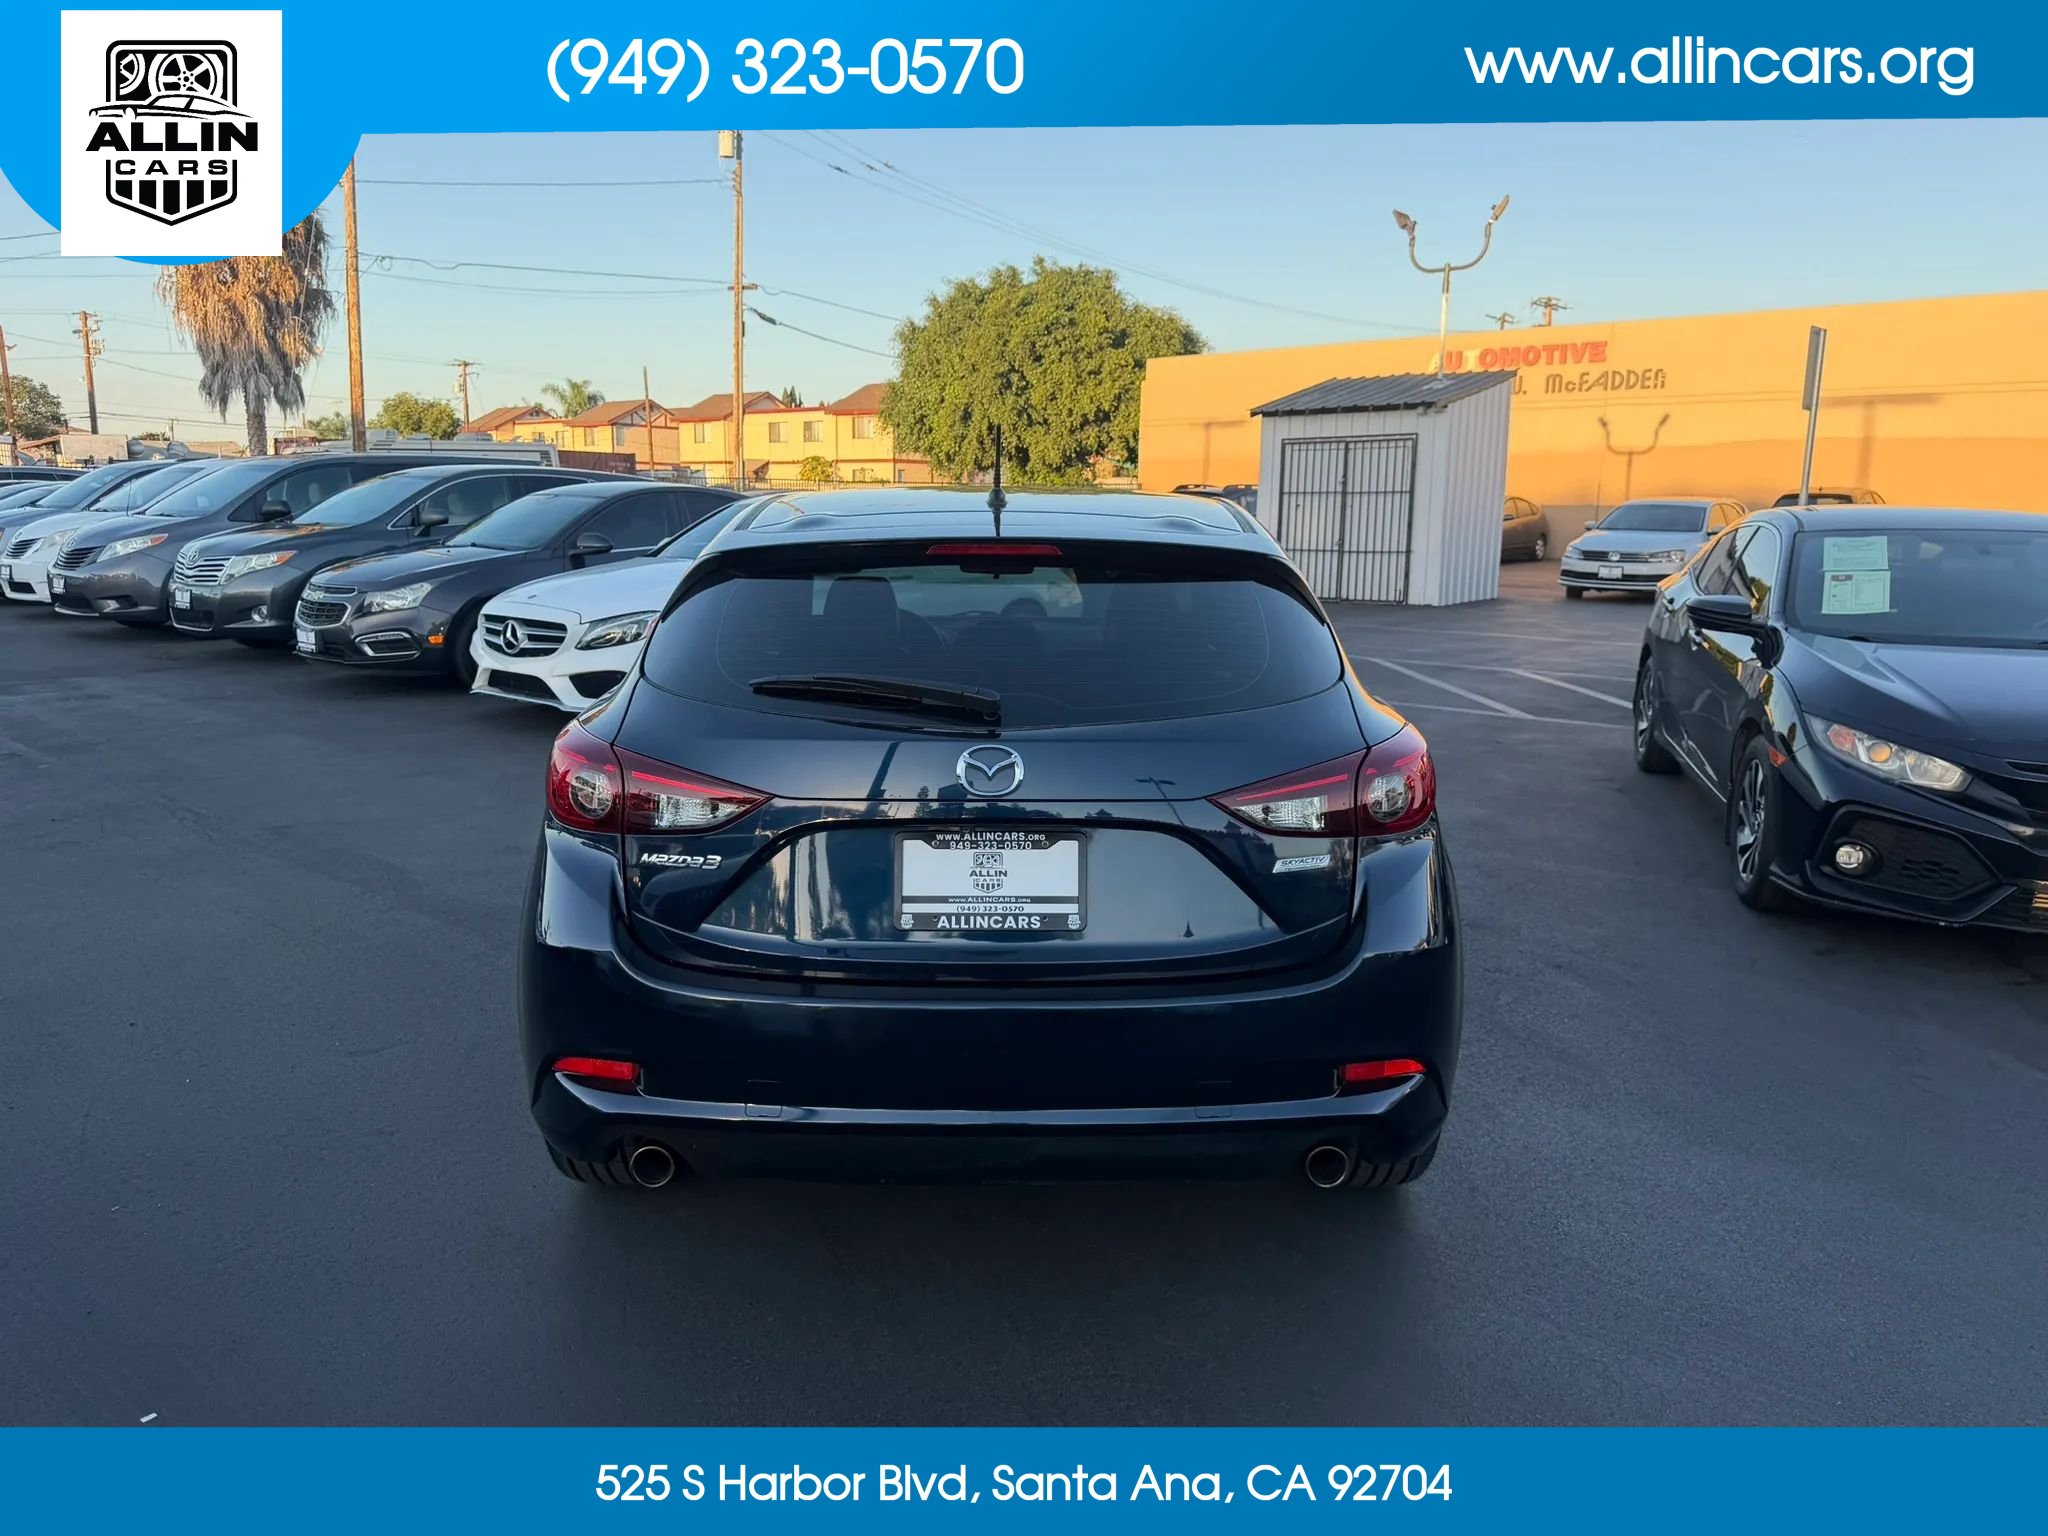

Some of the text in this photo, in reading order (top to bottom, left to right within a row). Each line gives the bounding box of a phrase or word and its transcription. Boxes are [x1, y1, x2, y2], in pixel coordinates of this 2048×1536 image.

[1427, 340, 1608, 373] AUTOMOTIVE
[949, 841, 1033, 850] 949-323-0570
[969, 870, 1008, 878] ALLIN
[956, 905, 981, 913] (949)
[937, 916, 1041, 929] ALLINCARS
